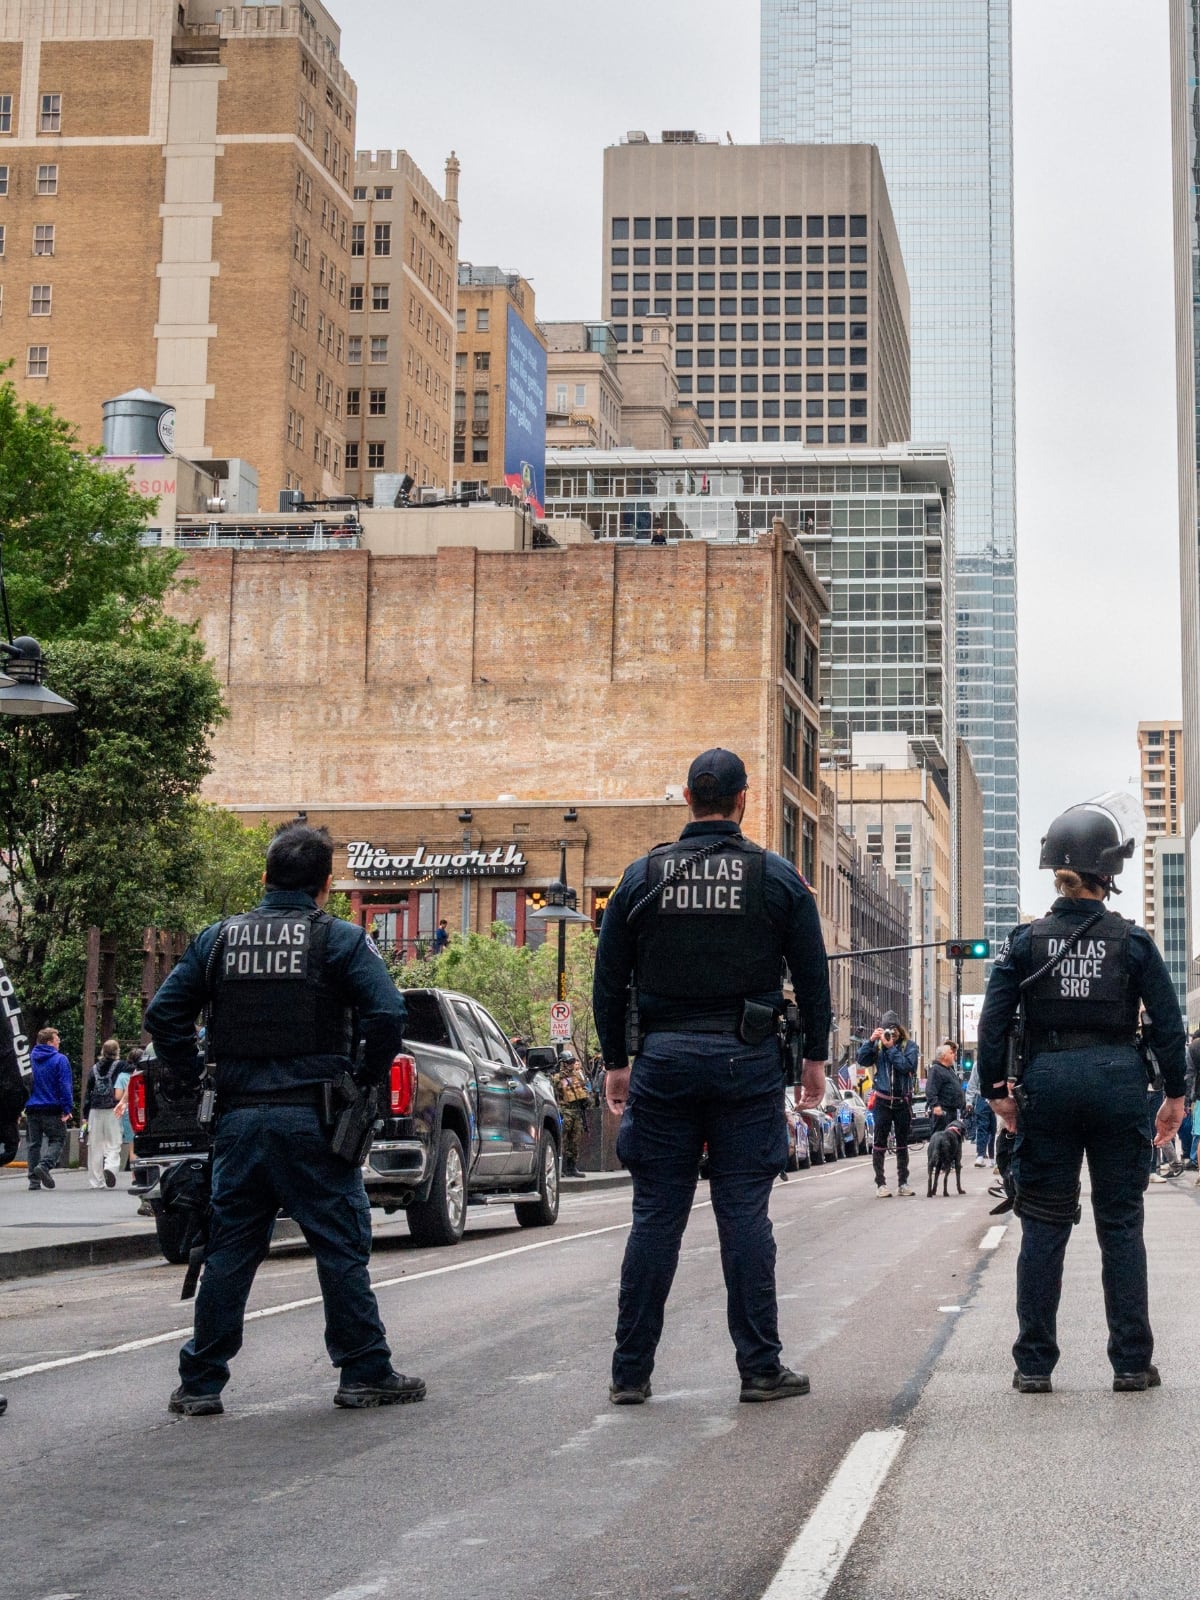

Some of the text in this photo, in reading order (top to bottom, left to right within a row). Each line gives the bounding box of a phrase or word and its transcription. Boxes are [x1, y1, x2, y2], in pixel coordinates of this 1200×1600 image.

[510, 326, 538, 373] Savings that
[510, 349, 543, 406] feel like getting
[509, 399, 518, 418] per
[526, 395, 538, 418] miles
[346, 841, 388, 857] The
[354, 866, 522, 877] restaurant and cocktail bar
[662, 858, 743, 881] DALLAS
[661, 885, 742, 910] POLICE
[227, 923, 306, 947] DALLAS
[225, 949, 303, 975] POLICE
[1060, 977, 1090, 998] SRG
